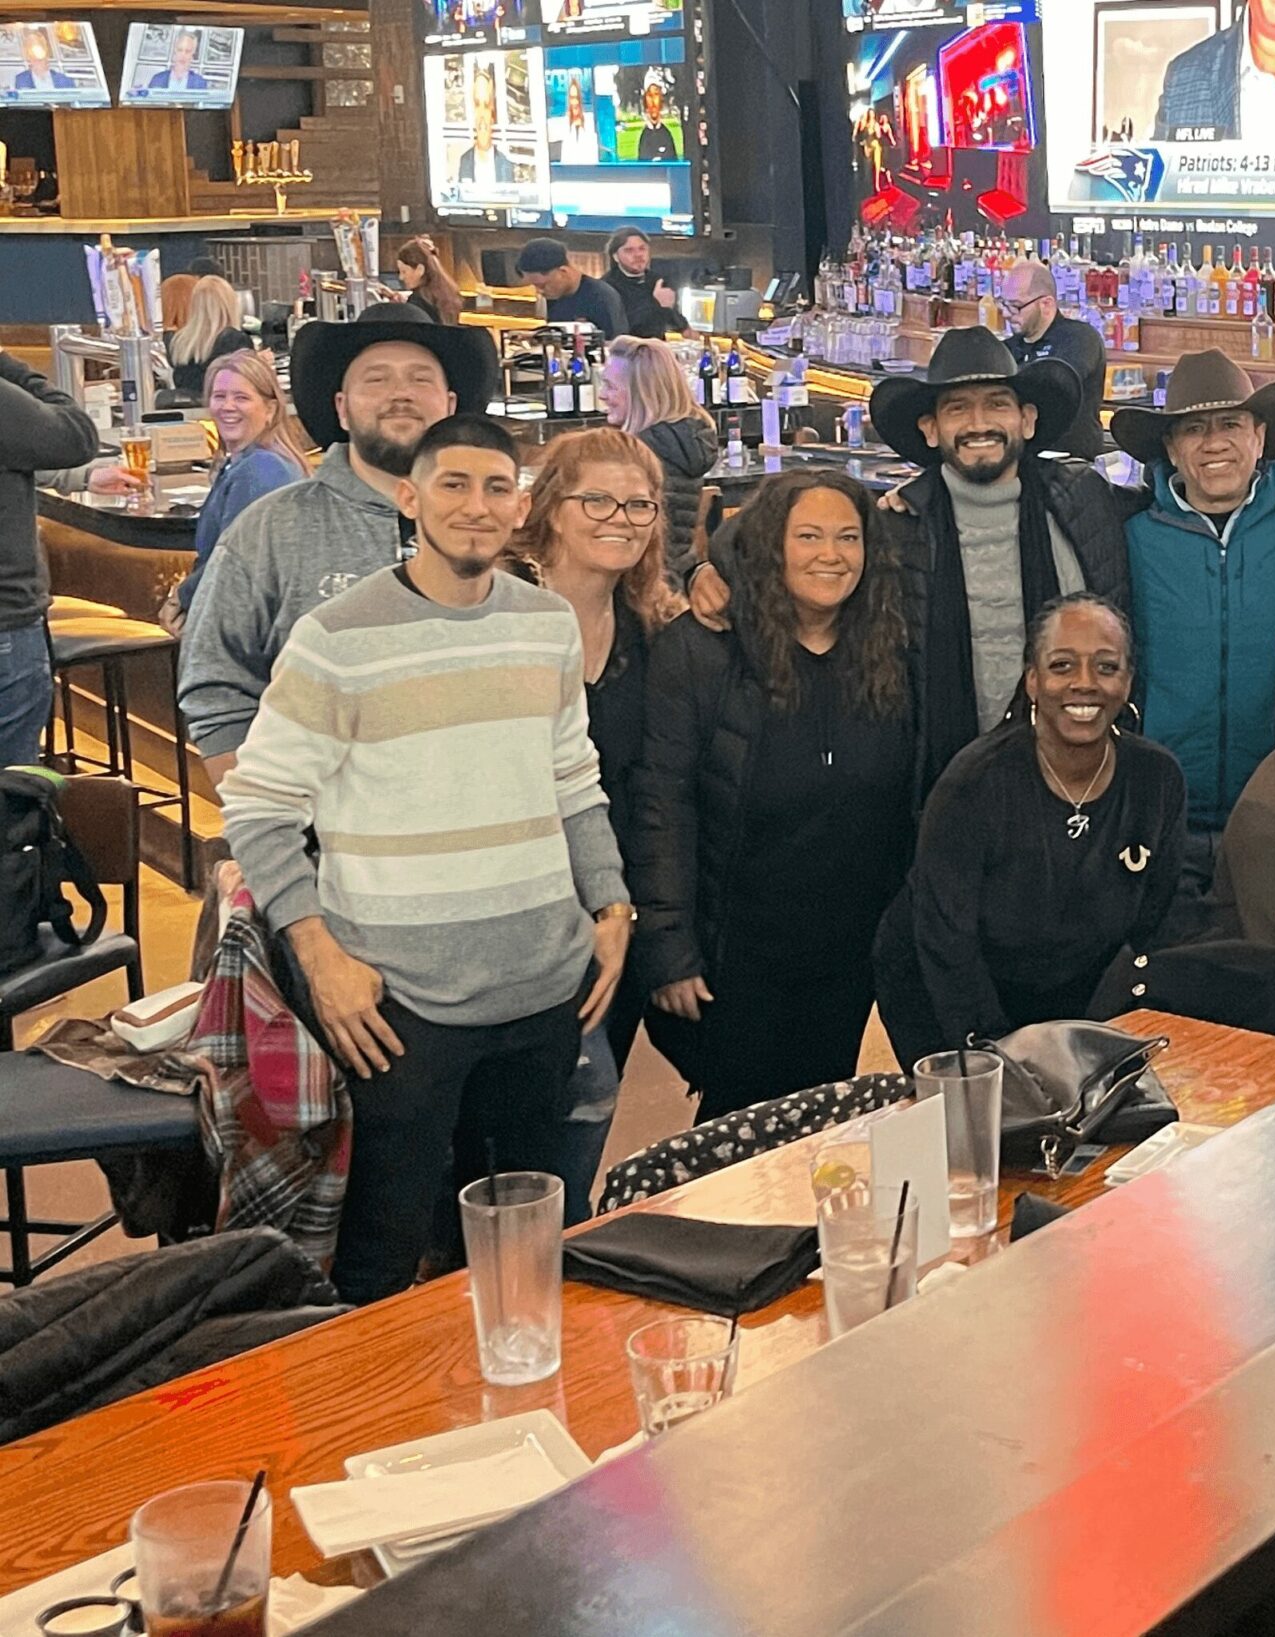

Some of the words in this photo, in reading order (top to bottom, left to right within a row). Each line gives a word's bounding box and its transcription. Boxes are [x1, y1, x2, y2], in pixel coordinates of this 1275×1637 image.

[1175, 128, 1194, 141] NFL
[1195, 128, 1216, 141] LIVE
[1178, 154, 1238, 173] Patriots:
[1239, 155, 1270, 171] 4-13
[1176, 179, 1209, 195] Hired
[1210, 179, 1239, 195] Mike
[1072, 217, 1106, 234] ESPN
[1160, 218, 1184, 232] Dame
[1195, 219, 1226, 233] Boston
[1226, 219, 1259, 237] College
